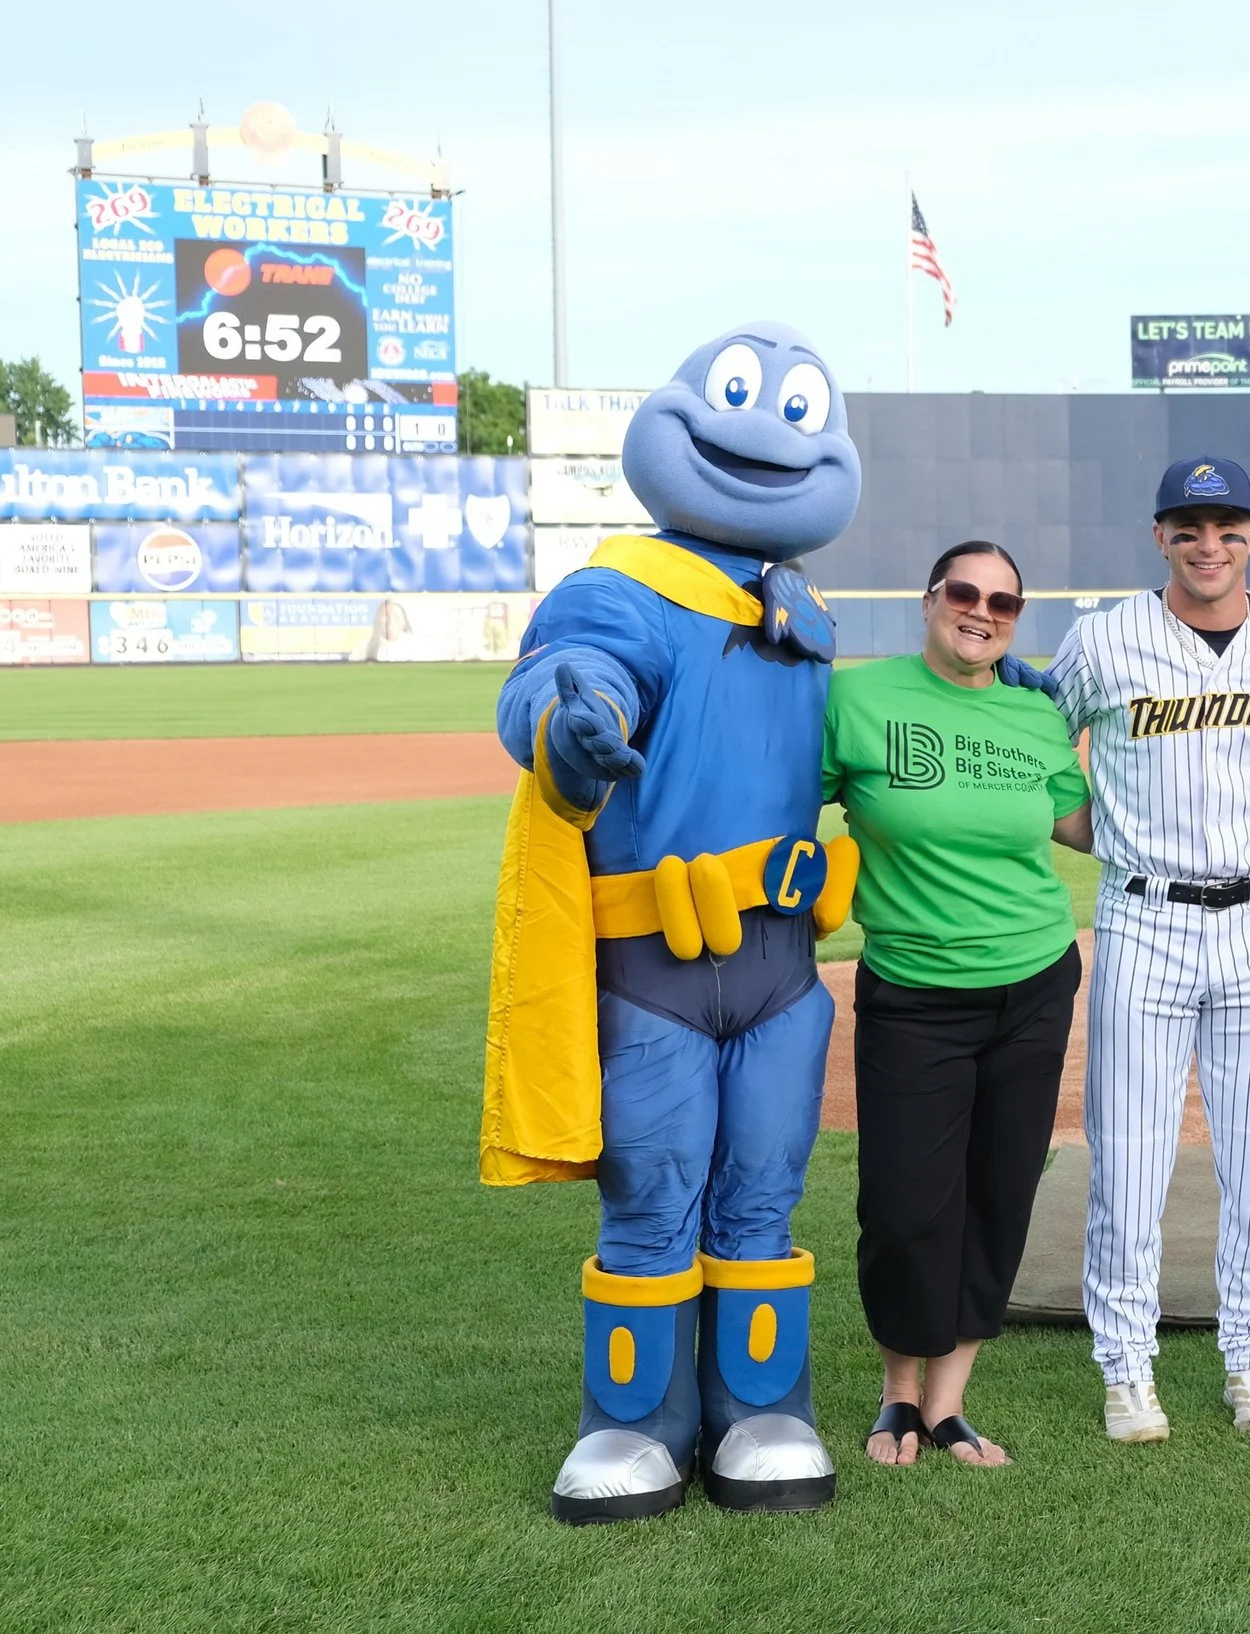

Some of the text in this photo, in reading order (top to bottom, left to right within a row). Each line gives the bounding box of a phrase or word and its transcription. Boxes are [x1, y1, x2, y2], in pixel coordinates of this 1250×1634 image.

[91, 189, 148, 223] 269
[173, 189, 365, 221] ELECTRICAL
[191, 214, 348, 244] WORKERS
[387, 205, 440, 239] 269
[261, 264, 335, 285] TRANE
[398, 273, 423, 286] NO
[372, 308, 412, 322] EARN
[203, 311, 342, 362] 6:52
[399, 319, 449, 334] LEARN
[1137, 321, 1189, 340] LET'S
[1193, 321, 1244, 340] TEAM
[1168, 358, 1248, 377] primepoint
[1162, 378, 1193, 386] PAYROLL
[1194, 378, 1229, 386] PROVIDER
[544, 394, 590, 412] TALK
[103, 465, 233, 509] Bank
[262, 515, 394, 549] Horizon
[1075, 597, 1100, 609] 407
[116, 635, 169, 654] 346
[955, 734, 1047, 770] Big Brothers
[955, 756, 1042, 781] Big Siste
[958, 781, 970, 789] OF
[973, 782, 1013, 791] MERCER
[777, 839, 816, 908] C
